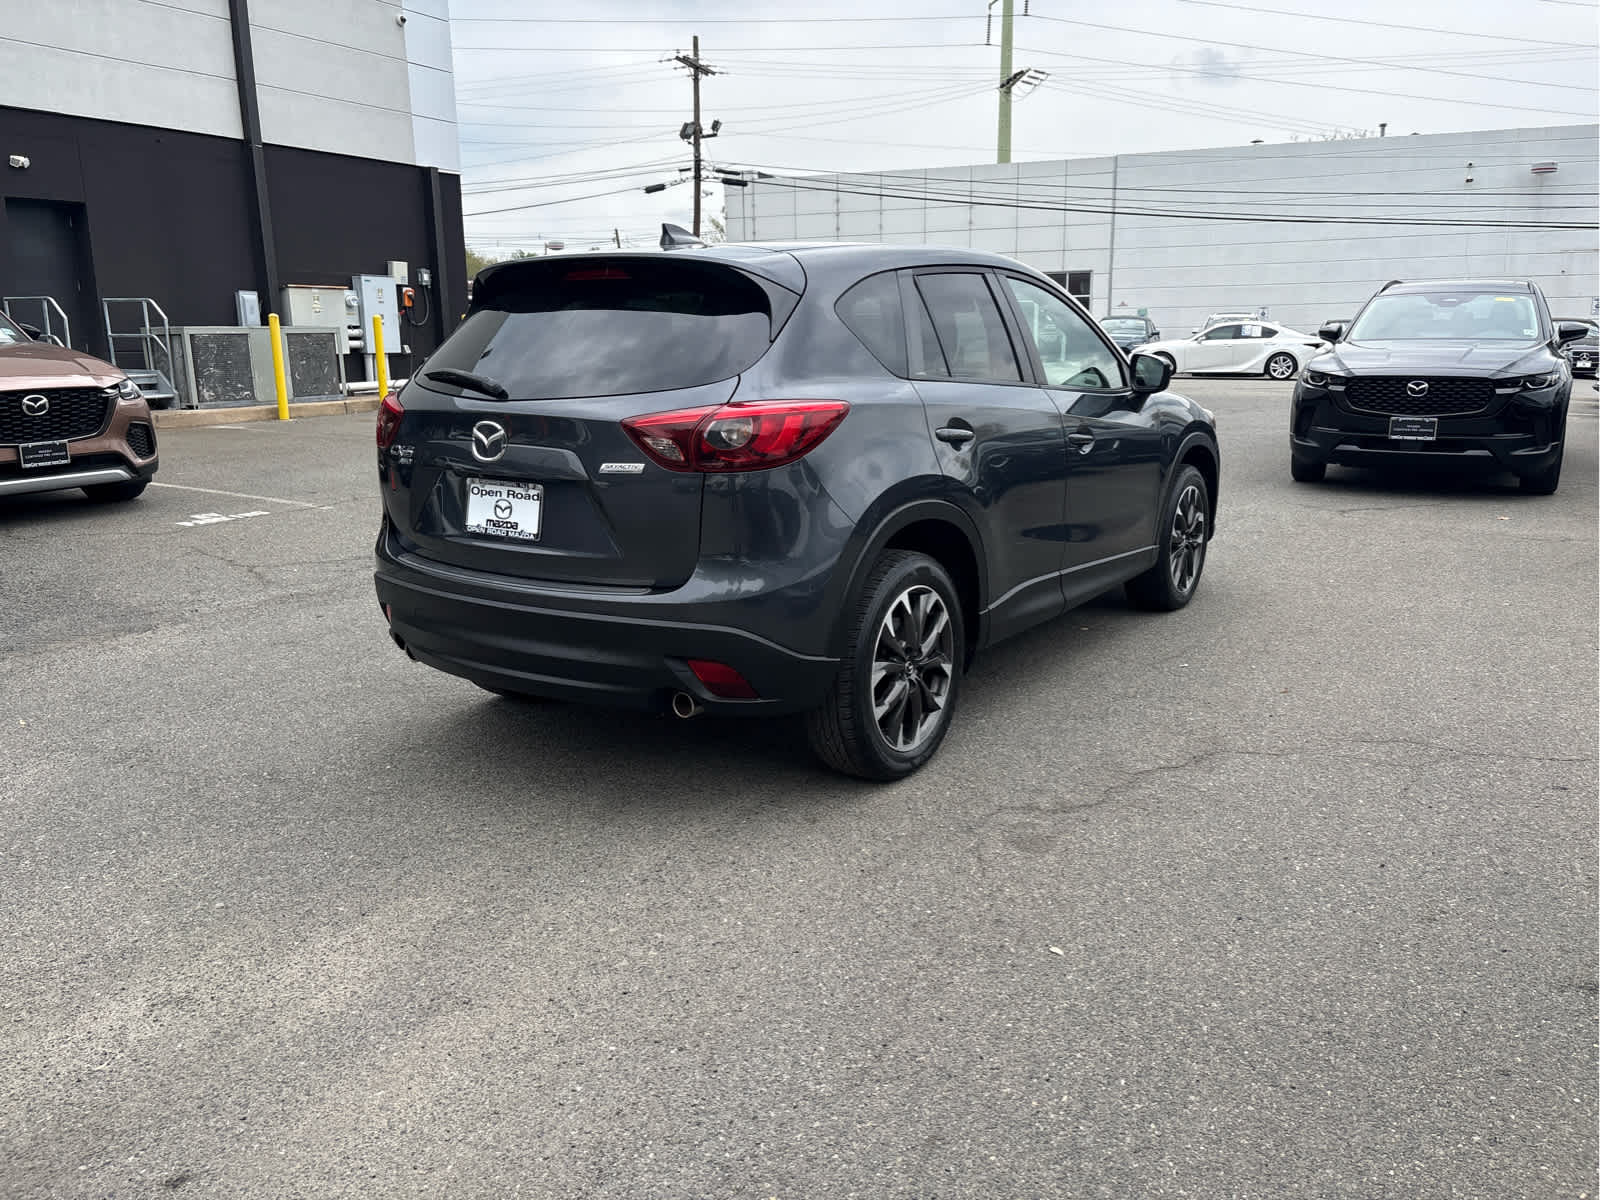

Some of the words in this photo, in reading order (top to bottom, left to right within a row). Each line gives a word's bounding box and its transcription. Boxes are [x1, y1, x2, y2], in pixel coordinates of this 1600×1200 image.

[471, 486, 502, 498] Open
[507, 489, 540, 501] Road
[485, 518, 519, 530] mazda
[467, 525, 486, 534] OPEN
[487, 528, 507, 536] ROAD
[508, 530, 535, 540] MAZDA
